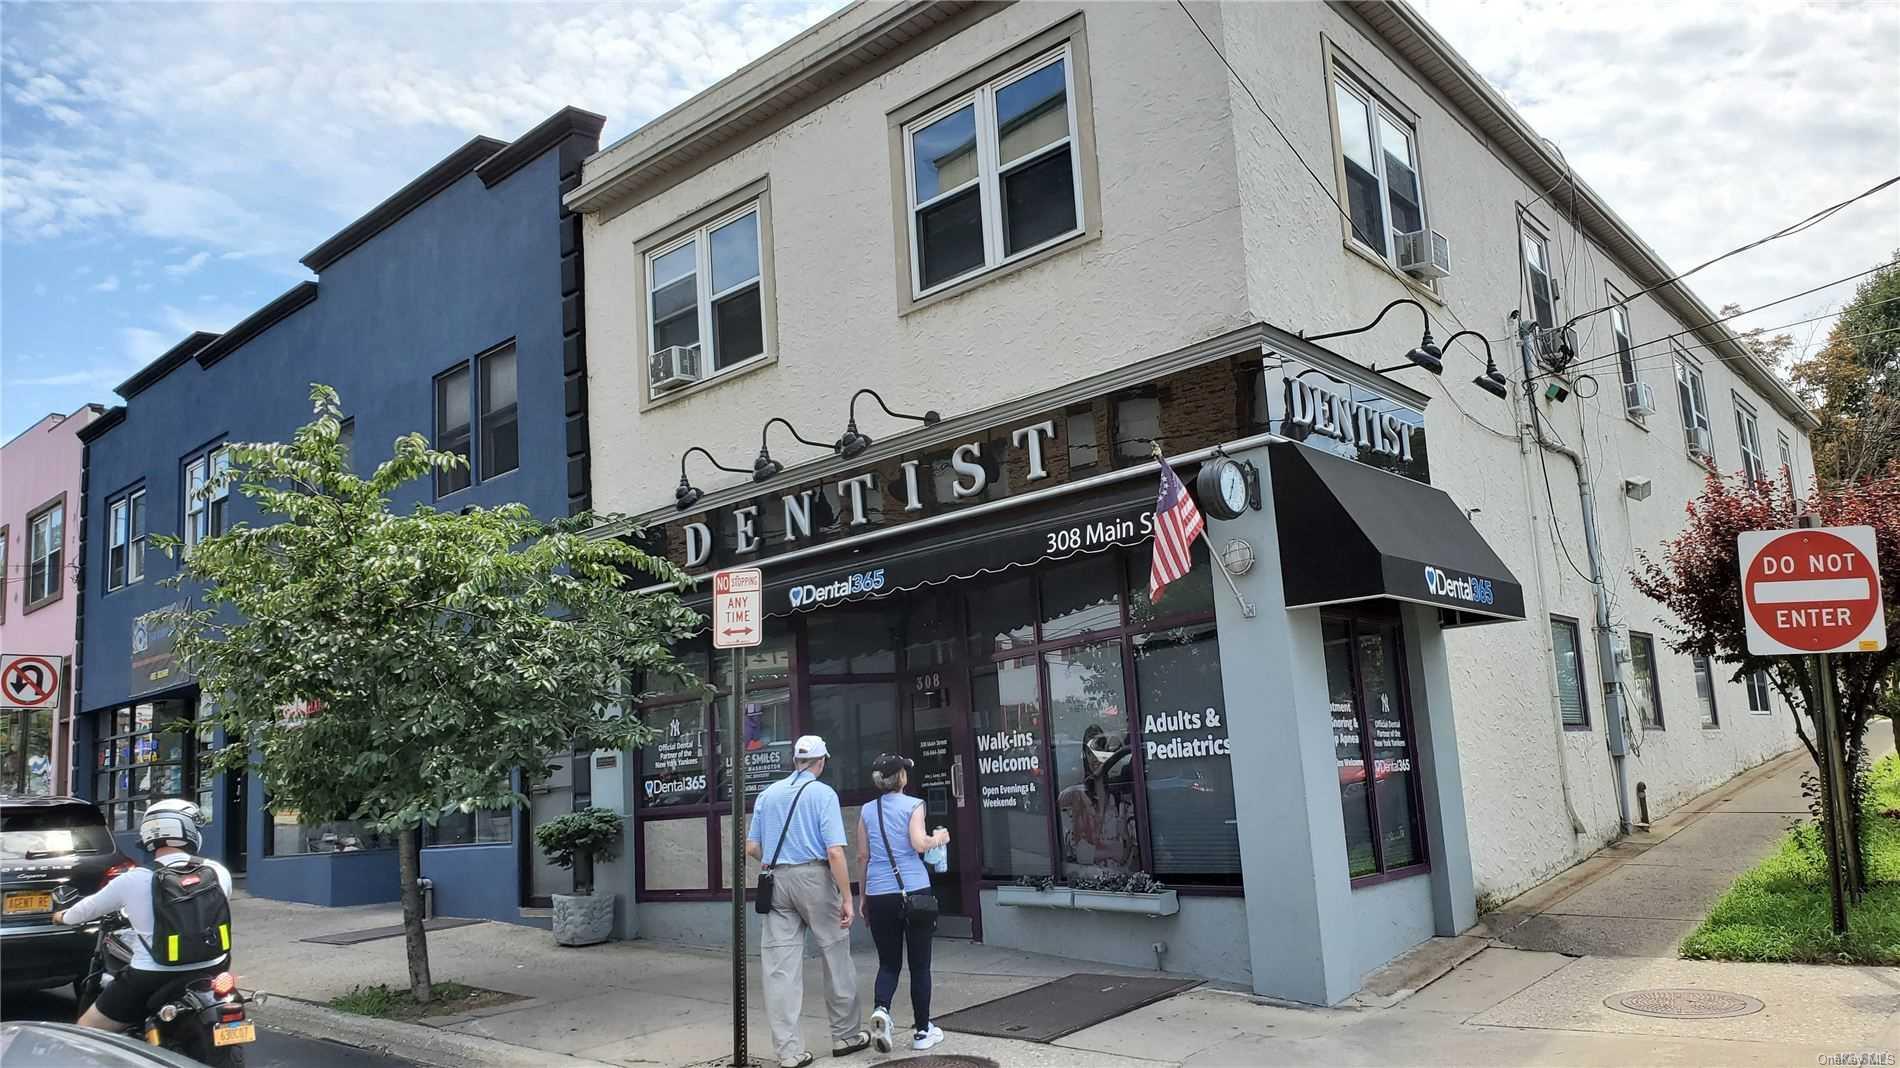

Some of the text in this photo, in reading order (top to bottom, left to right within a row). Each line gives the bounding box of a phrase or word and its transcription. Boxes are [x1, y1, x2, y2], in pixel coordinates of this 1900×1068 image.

[1290, 379, 1414, 461] DENTIST
[684, 420, 1055, 568] DENTIST
[1046, 528, 1081, 553] 308
[1086, 518, 1134, 545] Main
[1763, 553, 1855, 575] DO NOT
[717, 575, 758, 593] NO STOPPING
[802, 569, 885, 605] Dental365
[1435, 569, 1494, 605] Dental365
[728, 596, 748, 609] ANY
[725, 610, 751, 623] TIME
[1776, 608, 1852, 628] ENTER
[916, 673, 940, 690] 308
[1144, 707, 1221, 734] Adults &
[1374, 720, 1401, 728] Official Dental
[658, 740, 694, 752] Official Dental
[977, 730, 1033, 752] Walk-ins
[1146, 734, 1232, 760] Pediatrics
[1340, 734, 1359, 747] Apnea
[655, 761, 666, 769] New
[678, 758, 698, 766] Yankees
[660, 749, 692, 760] Partner of the
[751, 751, 780, 765] SMILES
[978, 755, 1039, 774] Welcome
[1379, 759, 1411, 773] Dental365
[653, 775, 706, 794] Dental365
[982, 782, 1036, 798] Open Evenings &
[982, 796, 1017, 808] Weekends
